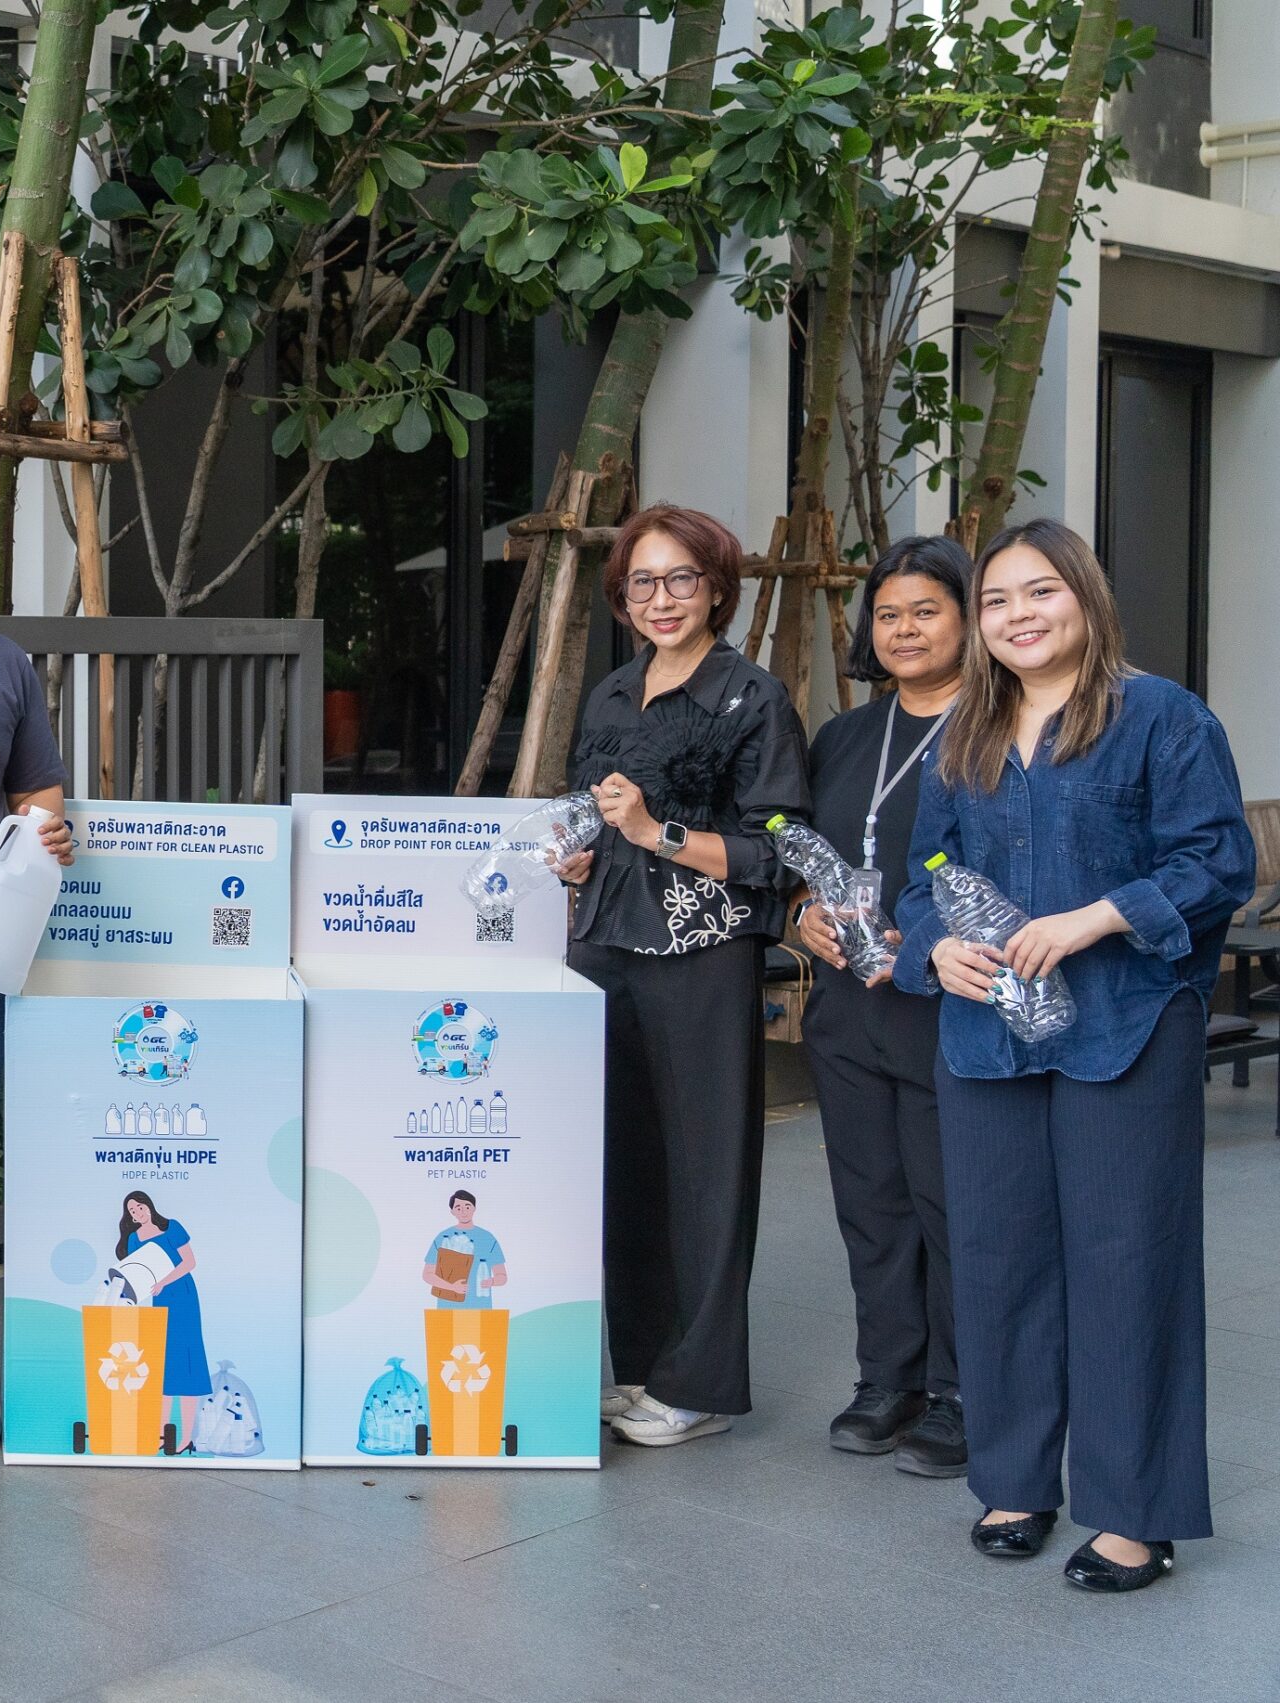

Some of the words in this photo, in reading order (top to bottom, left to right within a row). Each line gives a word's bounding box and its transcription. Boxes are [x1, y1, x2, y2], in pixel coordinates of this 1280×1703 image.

[88, 818, 226, 837] จุดรับพลาสติกสะอาด
[361, 817, 501, 837] จุดรับพลาสติกสะอาด
[87, 839, 117, 850] DROP
[120, 841, 153, 851] POINT
[156, 842, 177, 852] FOR
[181, 843, 215, 853] CLEAN
[219, 844, 264, 855] PLASTIC
[360, 839, 391, 849] DROP
[394, 839, 427, 849] POINT
[430, 840, 452, 850] FOR
[455, 841, 490, 851] CLEAN
[60, 880, 101, 894] วดนม
[323, 884, 423, 907] ขวดน้ำดื่มสีใส
[323, 910, 415, 933] ขวดน้ำอัดลม
[49, 924, 100, 948] ขวดสบู่
[106, 929, 173, 945] ยาสระผม
[95, 1146, 172, 1168] พลาสติกขุ่น
[177, 1150, 217, 1164] HDPE
[404, 1146, 478, 1162] พลาสติกใส
[483, 1149, 510, 1162] PET
[122, 1171, 147, 1179] HDPE
[150, 1171, 189, 1180] PLASTIC
[427, 1169, 444, 1179] PET
[447, 1170, 487, 1179] PLASTIC
